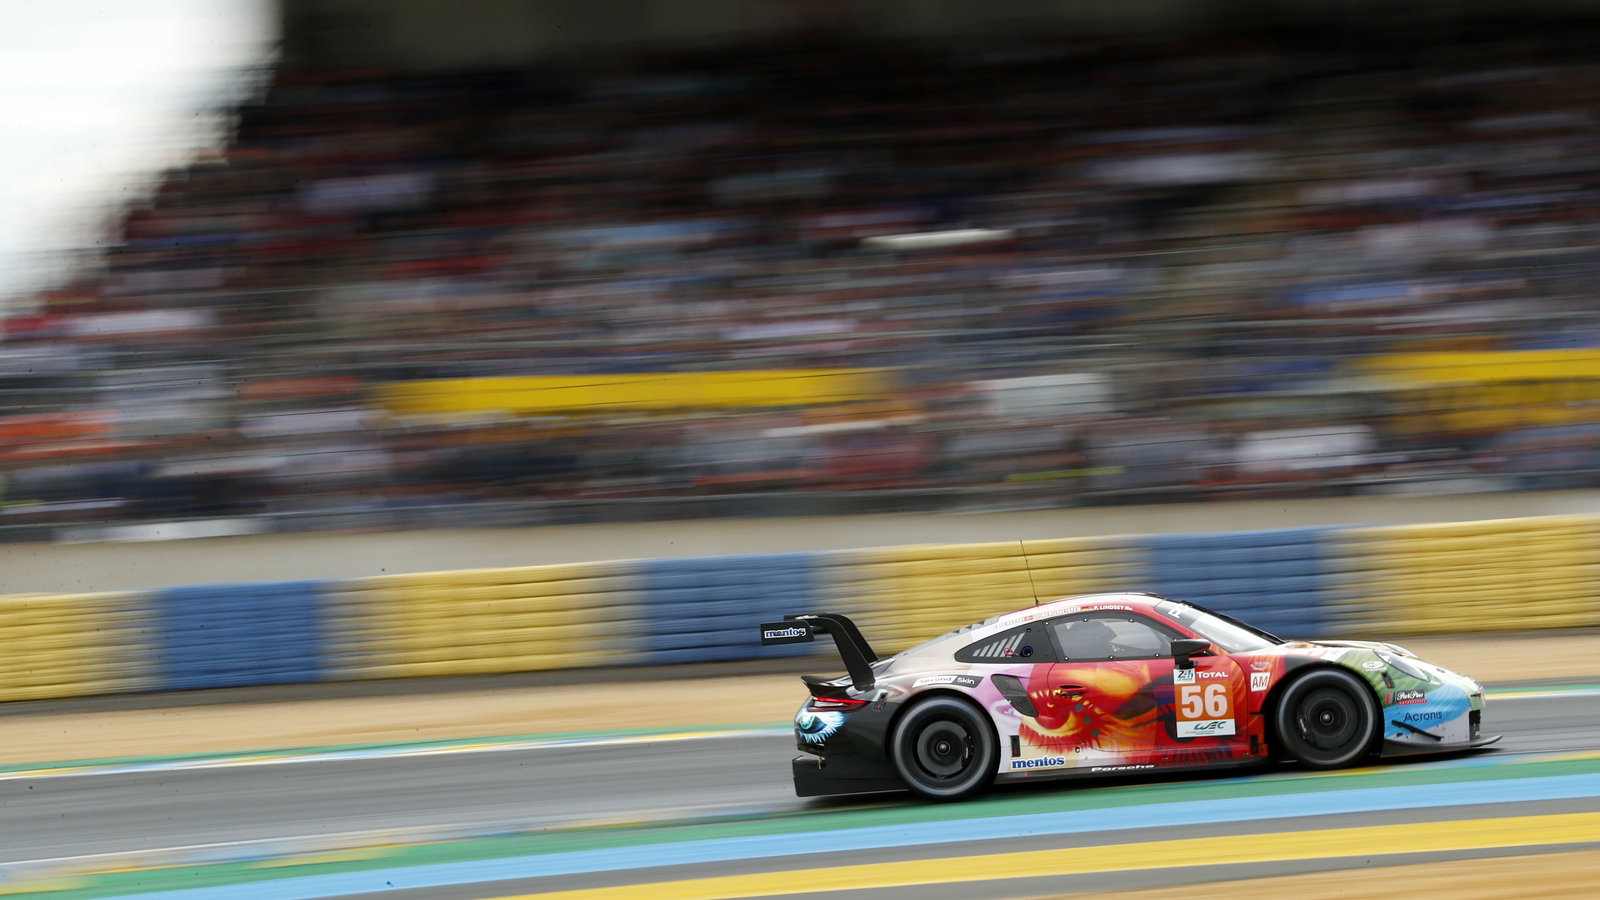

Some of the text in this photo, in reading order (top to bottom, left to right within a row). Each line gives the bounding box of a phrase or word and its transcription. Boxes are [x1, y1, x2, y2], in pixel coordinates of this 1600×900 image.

[764, 628, 806, 638] mentos
[1196, 671, 1229, 679] TOTAL
[957, 676, 975, 685] Skin
[1252, 675, 1269, 689] AM
[1181, 683, 1228, 719] 56
[1403, 711, 1443, 722] Acronis
[1193, 721, 1226, 730] WEC
[1011, 756, 1065, 769] mentos
[1091, 764, 1155, 772] Porsche
